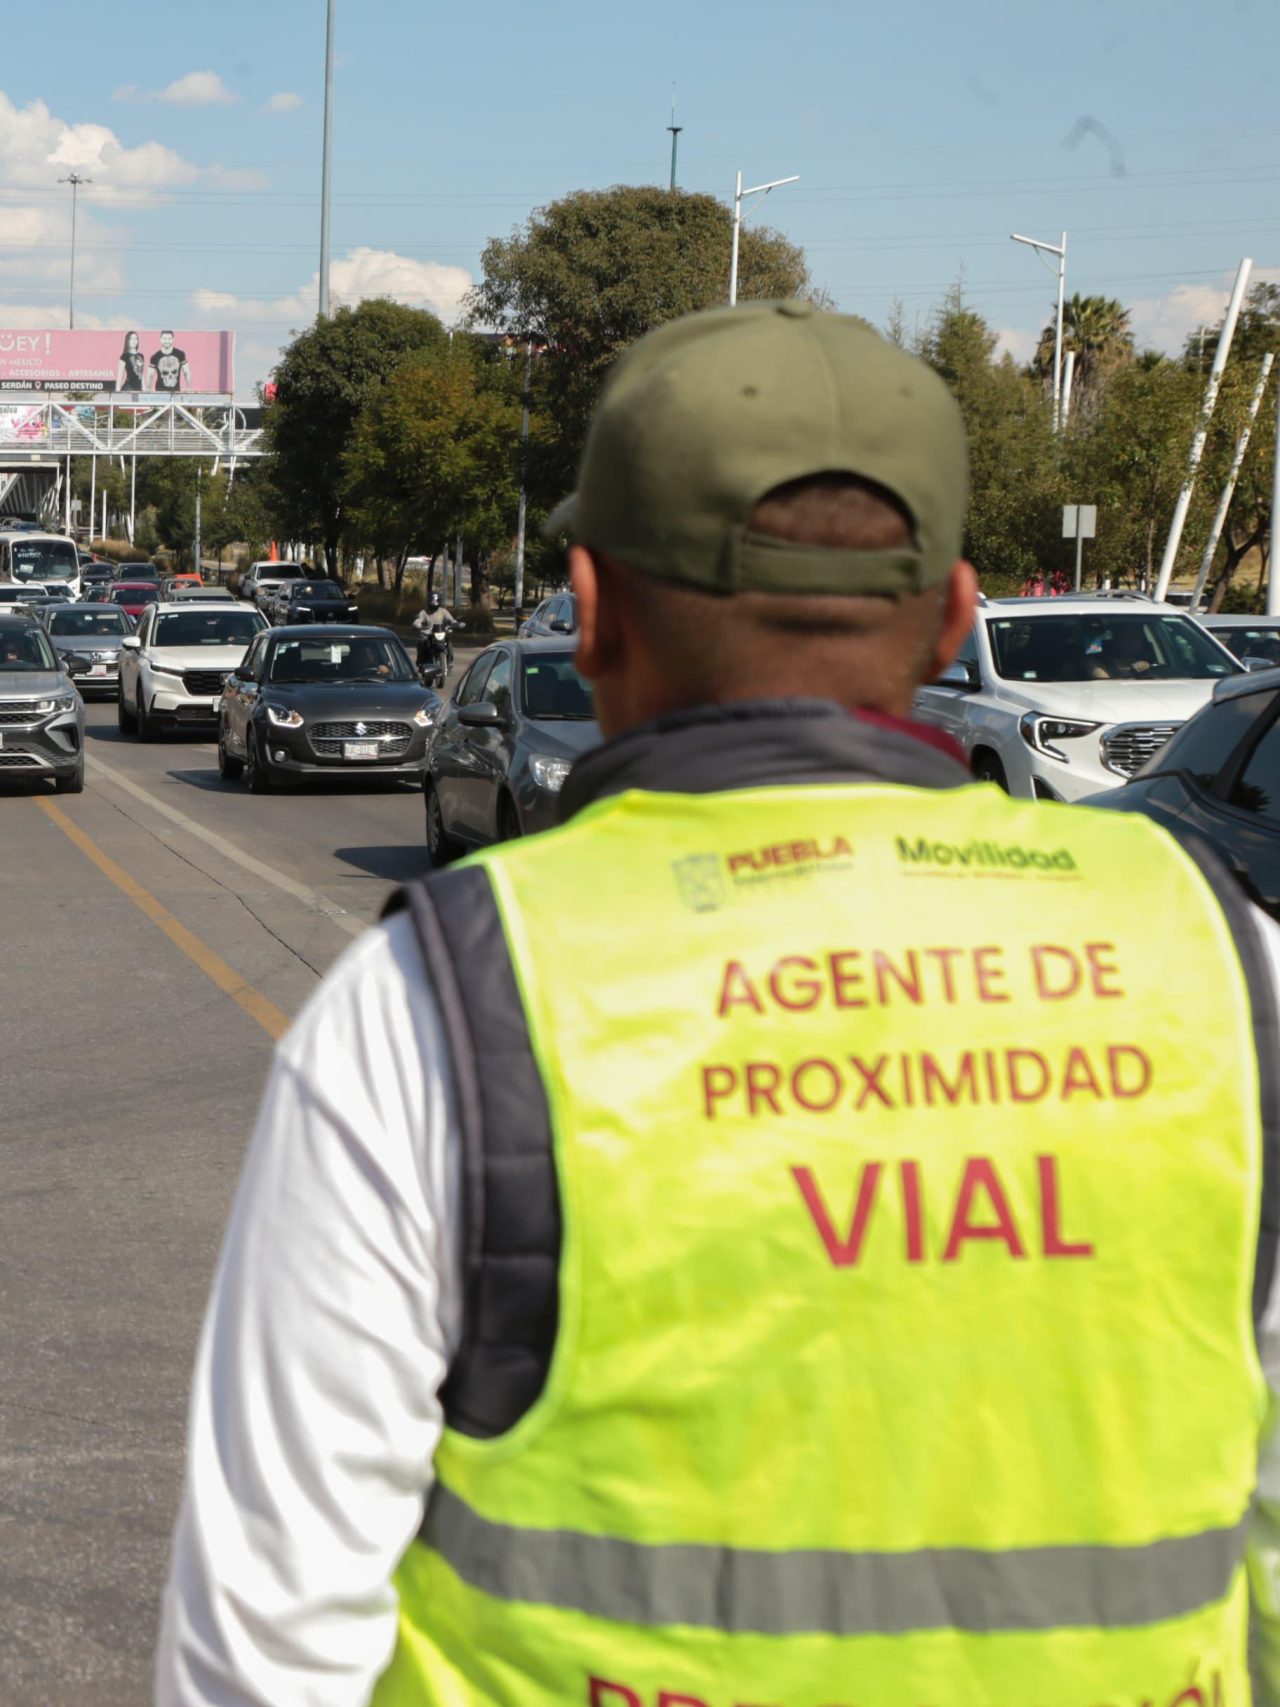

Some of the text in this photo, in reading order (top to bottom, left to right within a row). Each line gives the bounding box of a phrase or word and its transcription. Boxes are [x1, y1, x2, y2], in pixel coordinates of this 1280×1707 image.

[1, 380, 33, 390] SERDÁN
[9, 369, 60, 377] ACCESORIOS
[44, 382, 104, 390] PASEO DESTINO
[728, 835, 854, 876] PUEBLA
[895, 835, 1078, 871] Movilidad
[716, 942, 1126, 1018] AGENTE DE
[701, 1043, 1153, 1121] PROXIMIDAD
[788, 1154, 1096, 1269] VIAL
